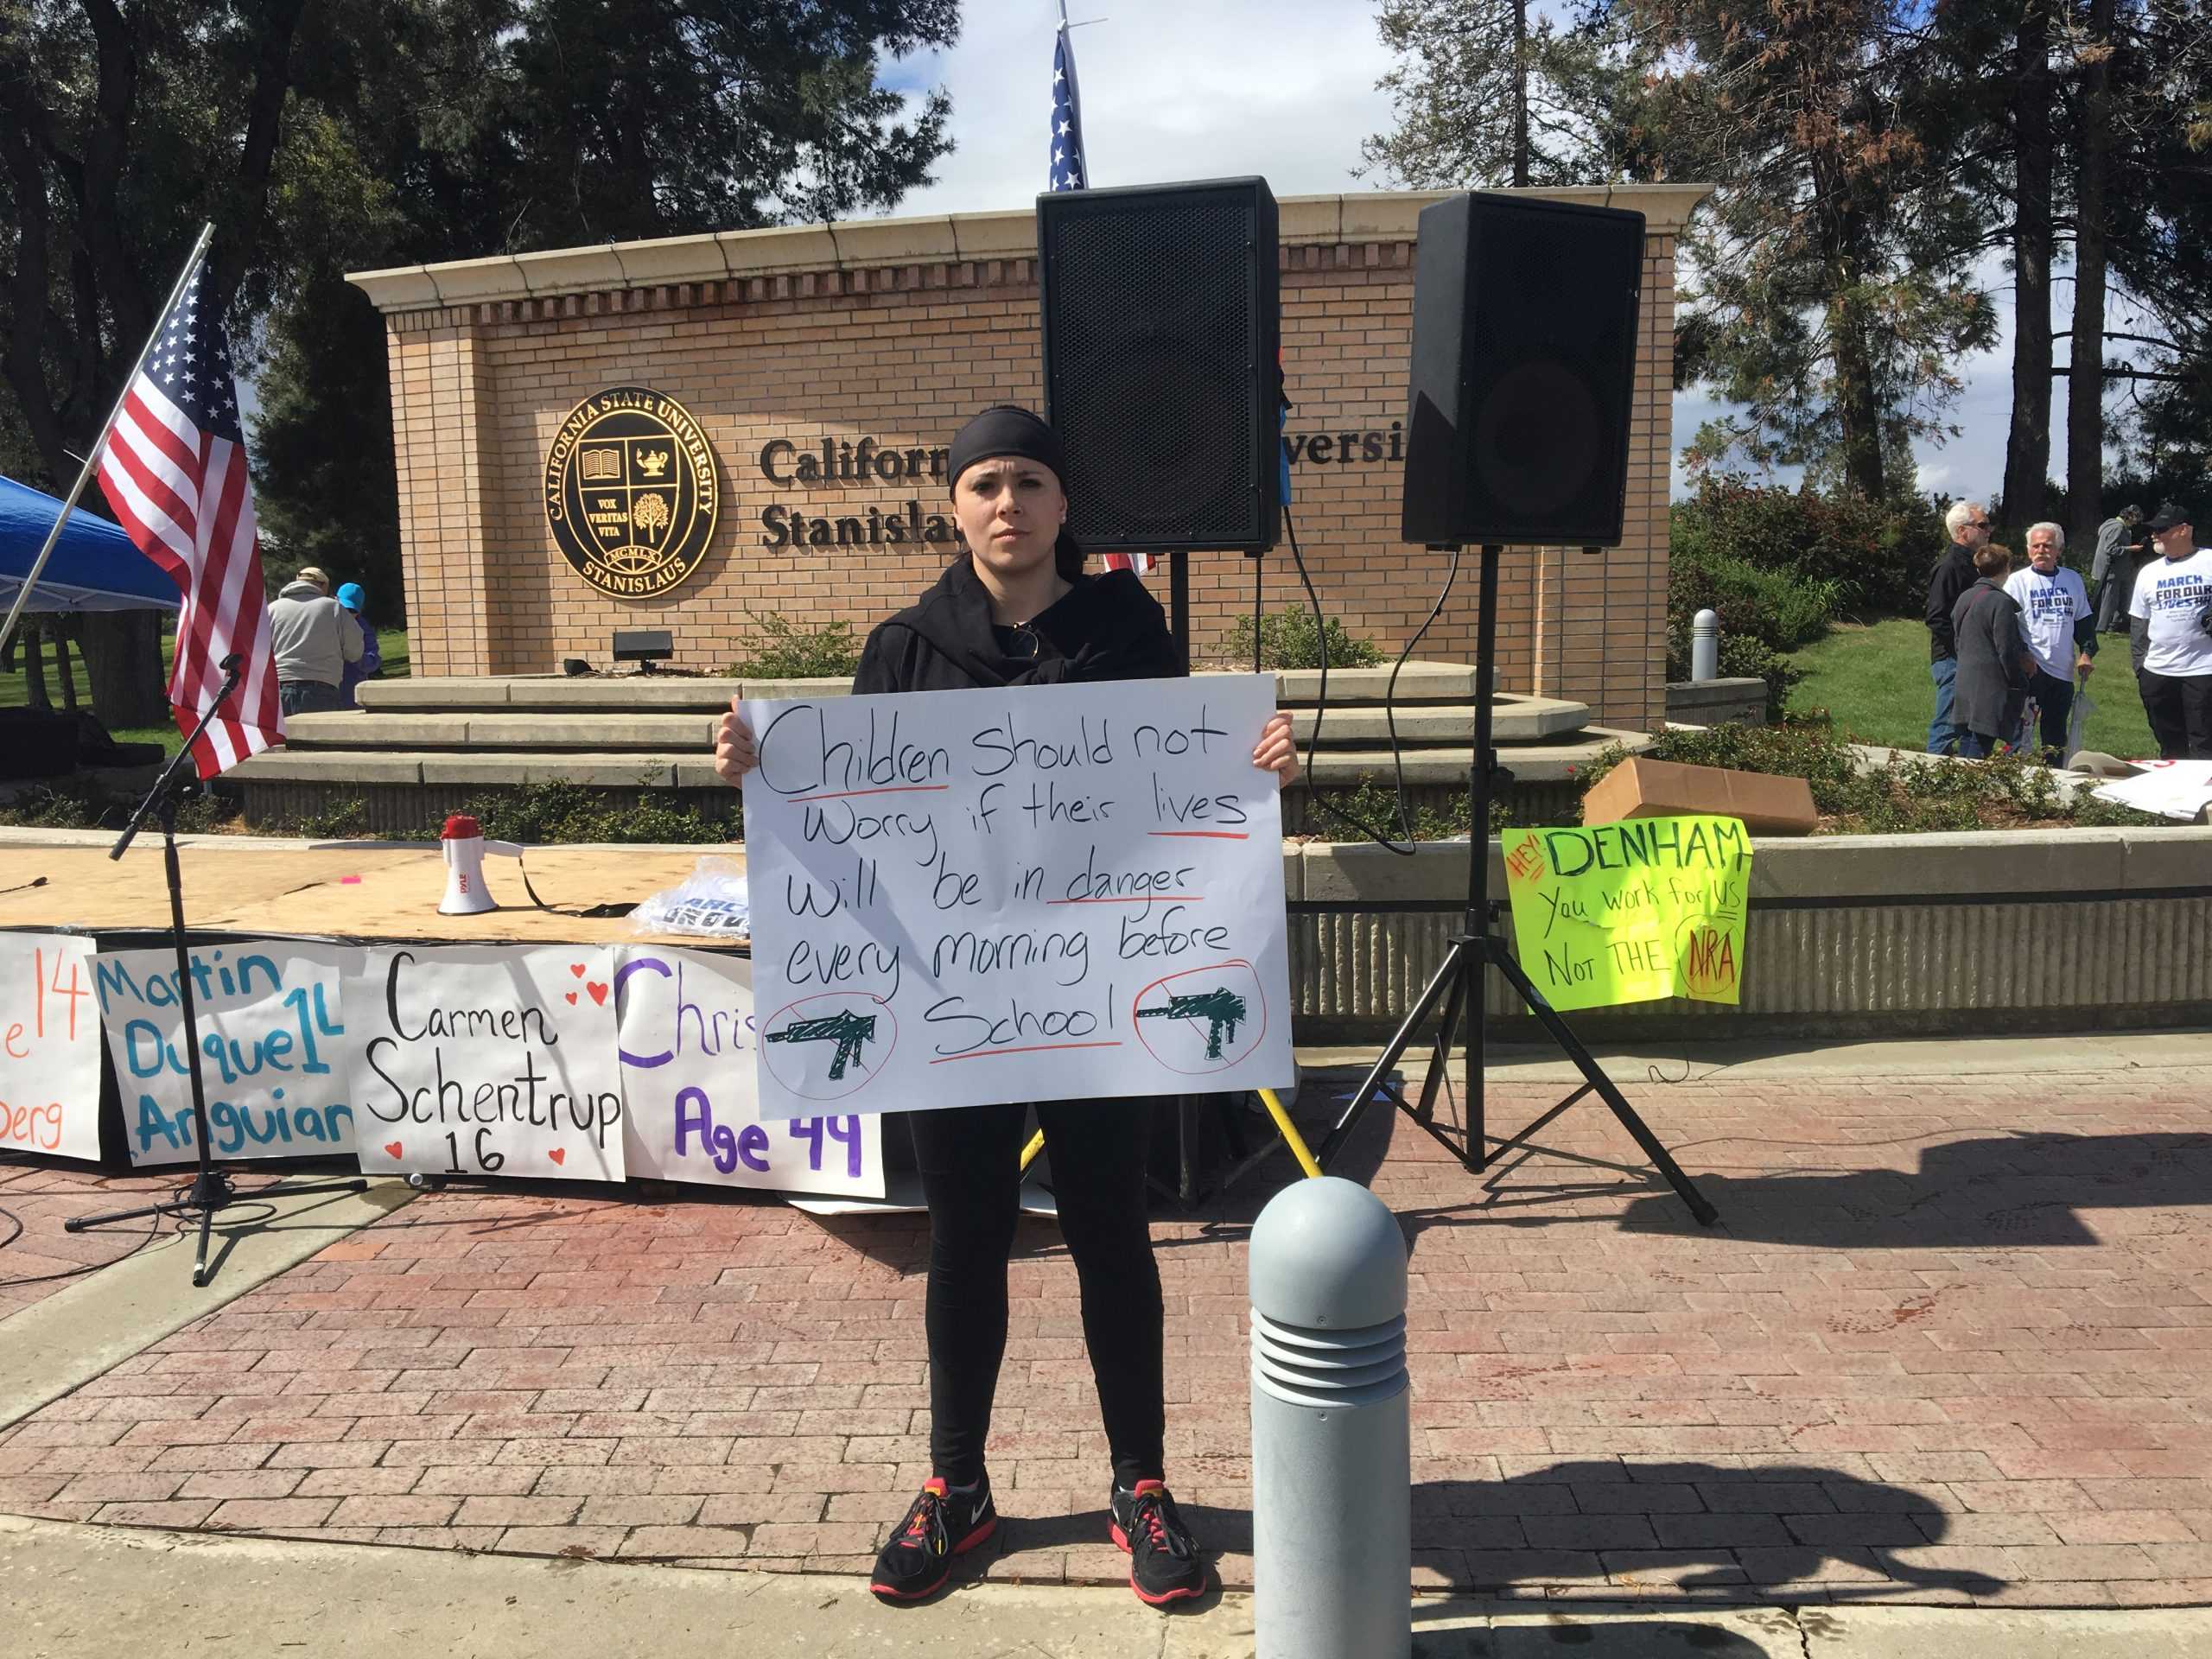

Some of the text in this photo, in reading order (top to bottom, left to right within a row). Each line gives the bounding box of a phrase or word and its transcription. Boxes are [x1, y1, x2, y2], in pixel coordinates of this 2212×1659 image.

[547, 391, 713, 521] CALIFORNIA STATE UNIVERSITY
[760, 421, 1405, 483] Californ versi
[589, 512, 628, 524] VERITAS
[598, 499, 616, 510] VOX
[598, 526, 620, 537] VITA
[761, 499, 953, 547] Stanisla
[582, 557, 686, 593] STANISLAUS
[609, 549, 658, 563] MCMLX
[2157, 575, 2203, 589] MARCH
[2030, 588, 2069, 598] MARCH
[2031, 597, 2074, 608] FOR OUR
[2157, 585, 2212, 601] FOR OUR
[759, 705, 950, 794] Children
[1134, 704, 1229, 758] not
[966, 783, 1007, 835] if
[1022, 781, 1116, 830] their
[1153, 772, 1248, 824] lives
[1544, 821, 1744, 877] DENHAM
[459, 874, 467, 893] PYLE
[933, 851, 982, 910] be
[1014, 861, 1044, 900] in
[1066, 845, 1196, 923] danger
[1538, 887, 1588, 940] You
[96, 950, 283, 1014] Martin
[786, 906, 1230, 1005] every morning before
[1605, 940, 1672, 976] THE
[1689, 929, 1735, 983] NRA
[35, 946, 90, 1041] 14
[386, 950, 558, 1046] Carmen
[124, 1018, 295, 1084] Duque
[365, 1036, 621, 1149] Schentrup
[445, 1127, 505, 1174] 16
[674, 1086, 861, 1178] Age 49
